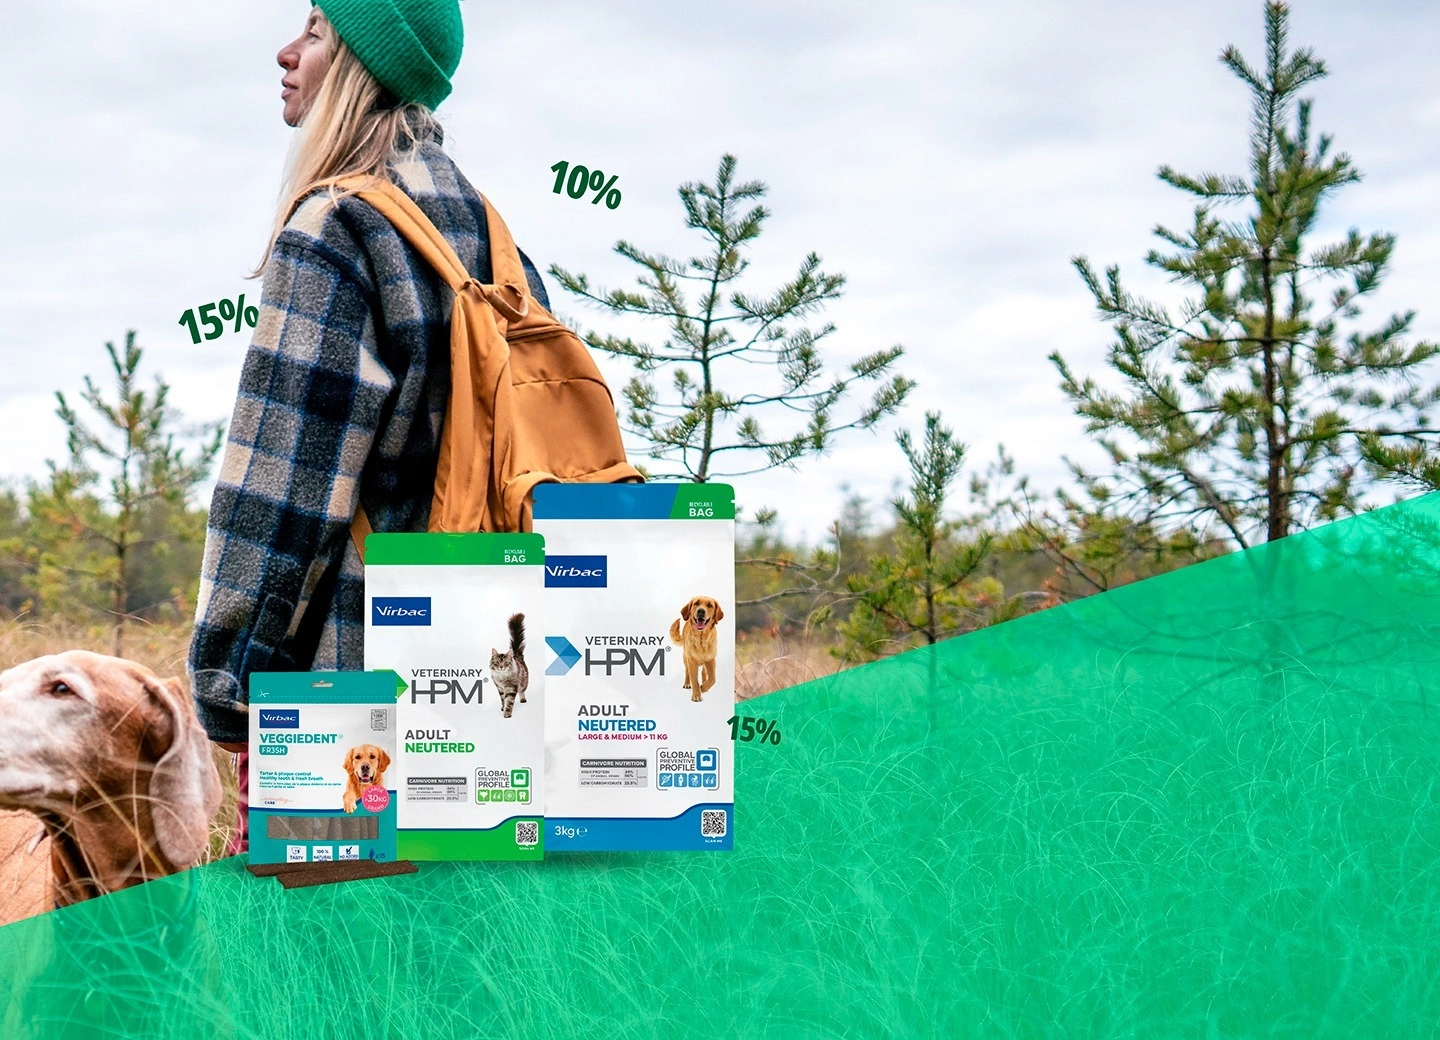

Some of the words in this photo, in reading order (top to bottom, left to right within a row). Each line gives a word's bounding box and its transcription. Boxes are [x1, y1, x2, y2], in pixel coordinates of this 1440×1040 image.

[689, 508, 714, 517] BAG
[505, 555, 526, 563] BAG
[545, 565, 603, 577] Virbac
[376, 606, 427, 617] Virbac
[585, 636, 665, 646] VETERINARY
[411, 668, 483, 678] VETERINARY
[577, 705, 629, 717] ADULT
[262, 714, 297, 722] Virbac
[578, 719, 657, 731] NEUTERED
[405, 729, 451, 740] ADULT
[405, 742, 475, 753] NEUTERED
[659, 751, 696, 759] GLOBAL
[660, 763, 696, 771] PROFILE
[554, 825, 575, 839] 3kg
